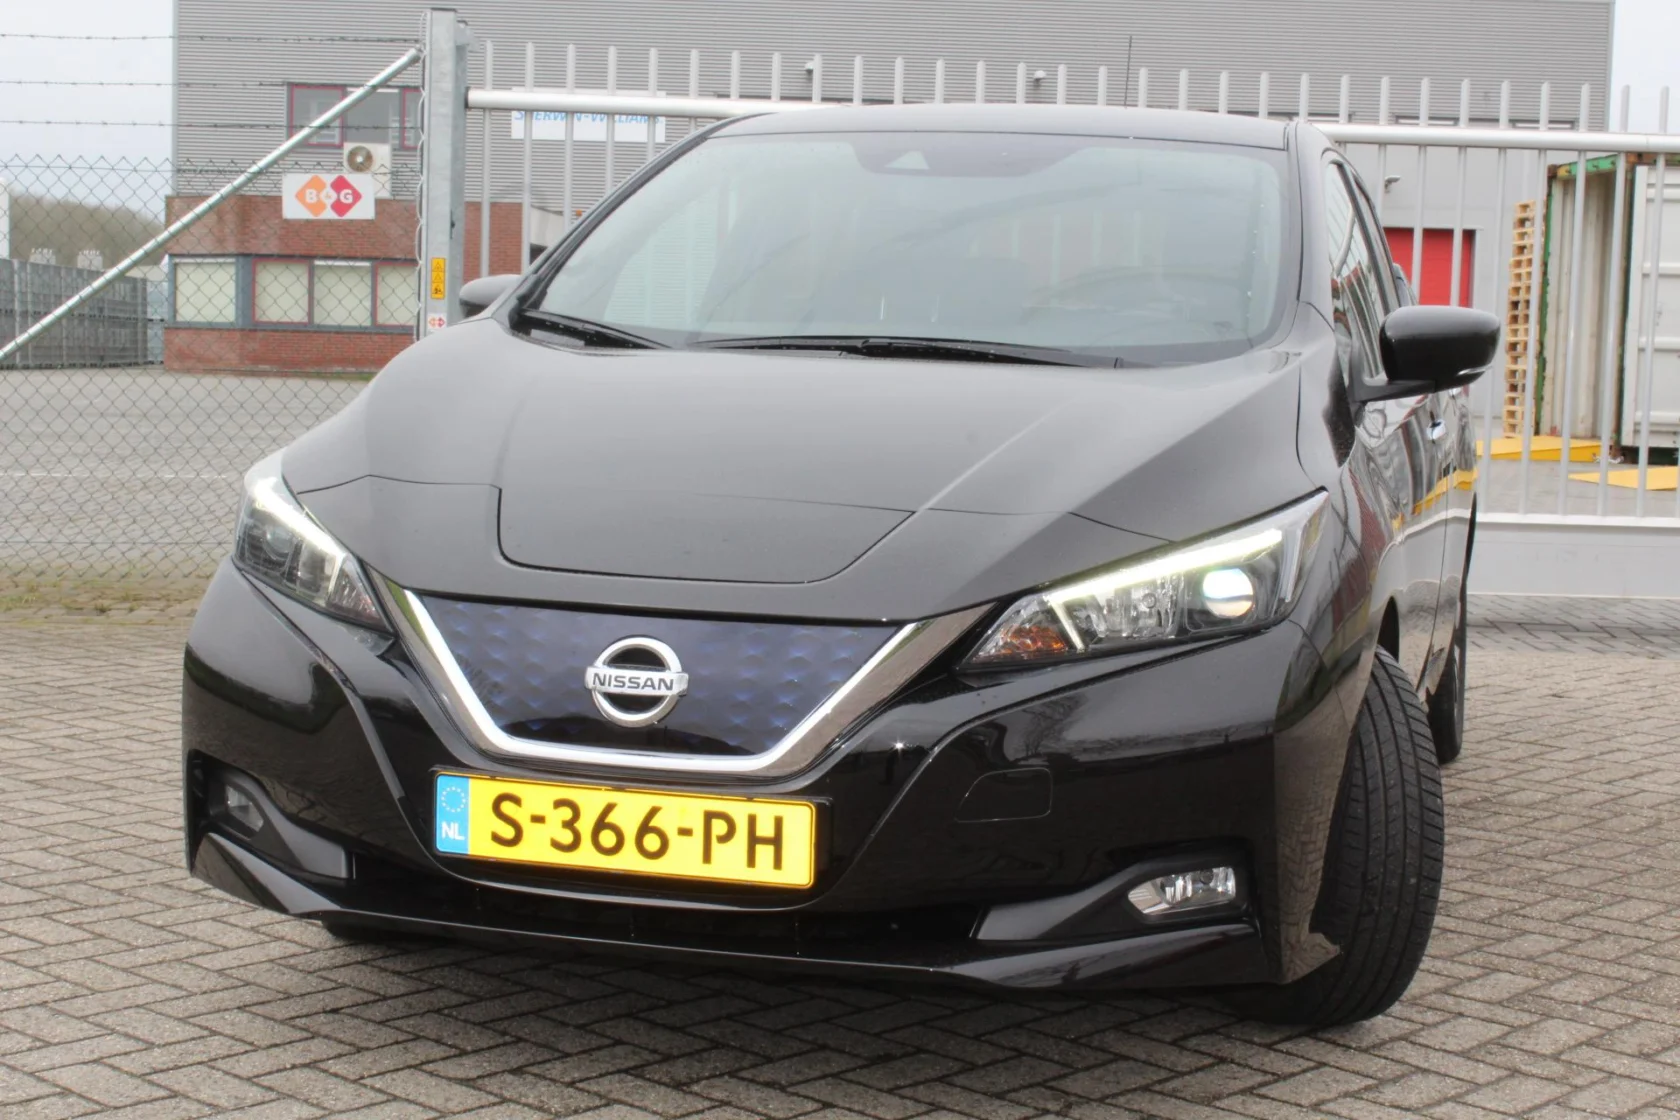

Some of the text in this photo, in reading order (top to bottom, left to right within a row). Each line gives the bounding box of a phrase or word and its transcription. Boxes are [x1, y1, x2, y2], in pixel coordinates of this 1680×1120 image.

[592, 672, 674, 691] NISSAN
[441, 821, 465, 840] NL
[490, 792, 783, 871] S-366-PH
